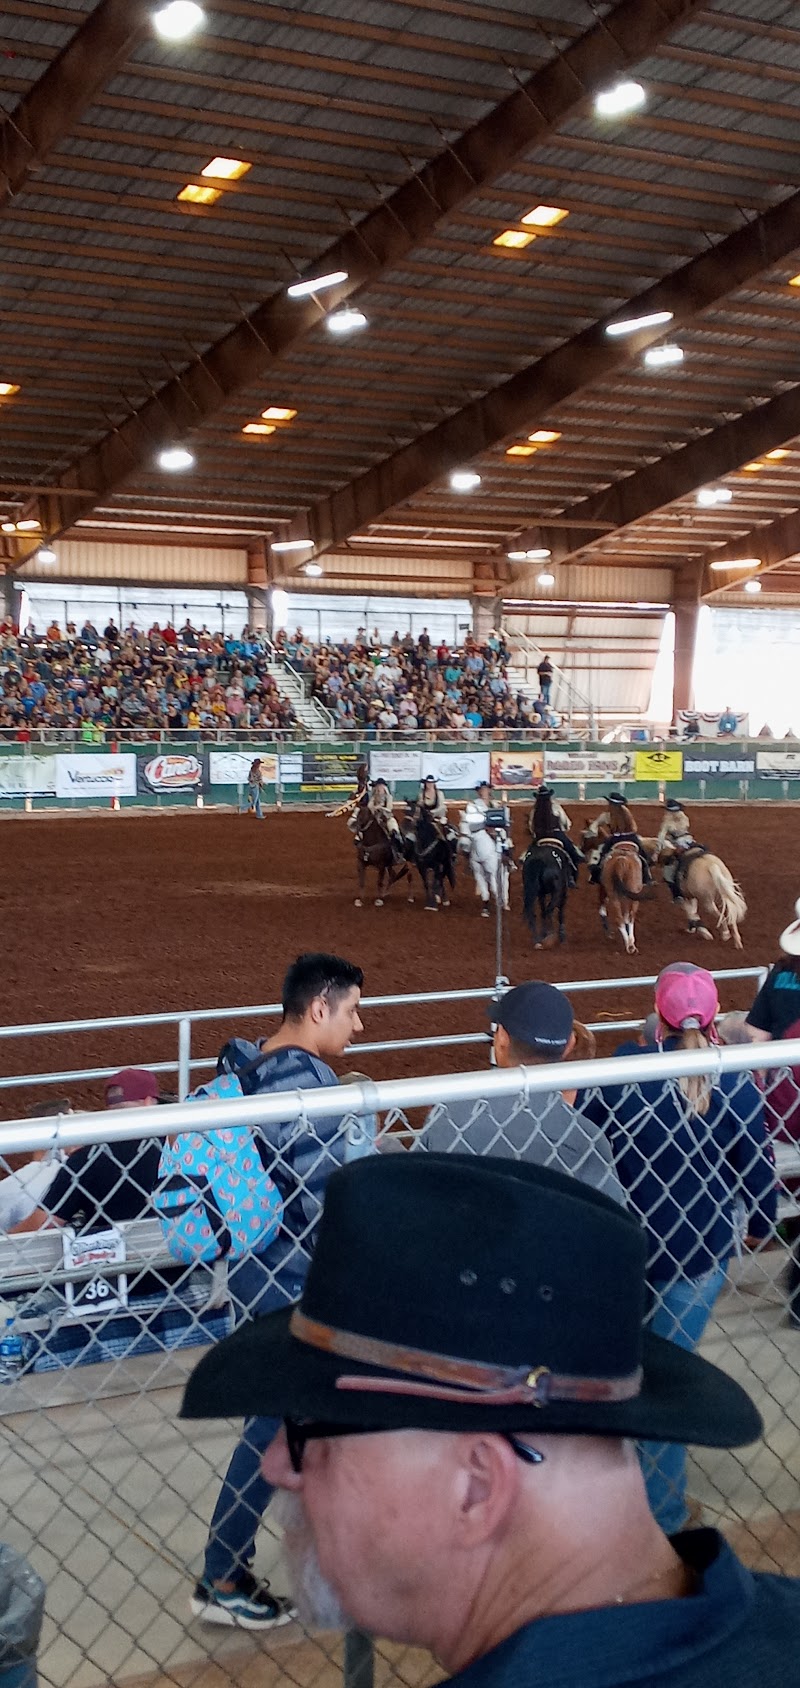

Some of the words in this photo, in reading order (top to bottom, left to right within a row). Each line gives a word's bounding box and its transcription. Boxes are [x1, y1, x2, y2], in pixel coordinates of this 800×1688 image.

[684, 760, 719, 773] BOOT
[719, 760, 755, 773] BARN
[85, 1280, 110, 1300] 36
